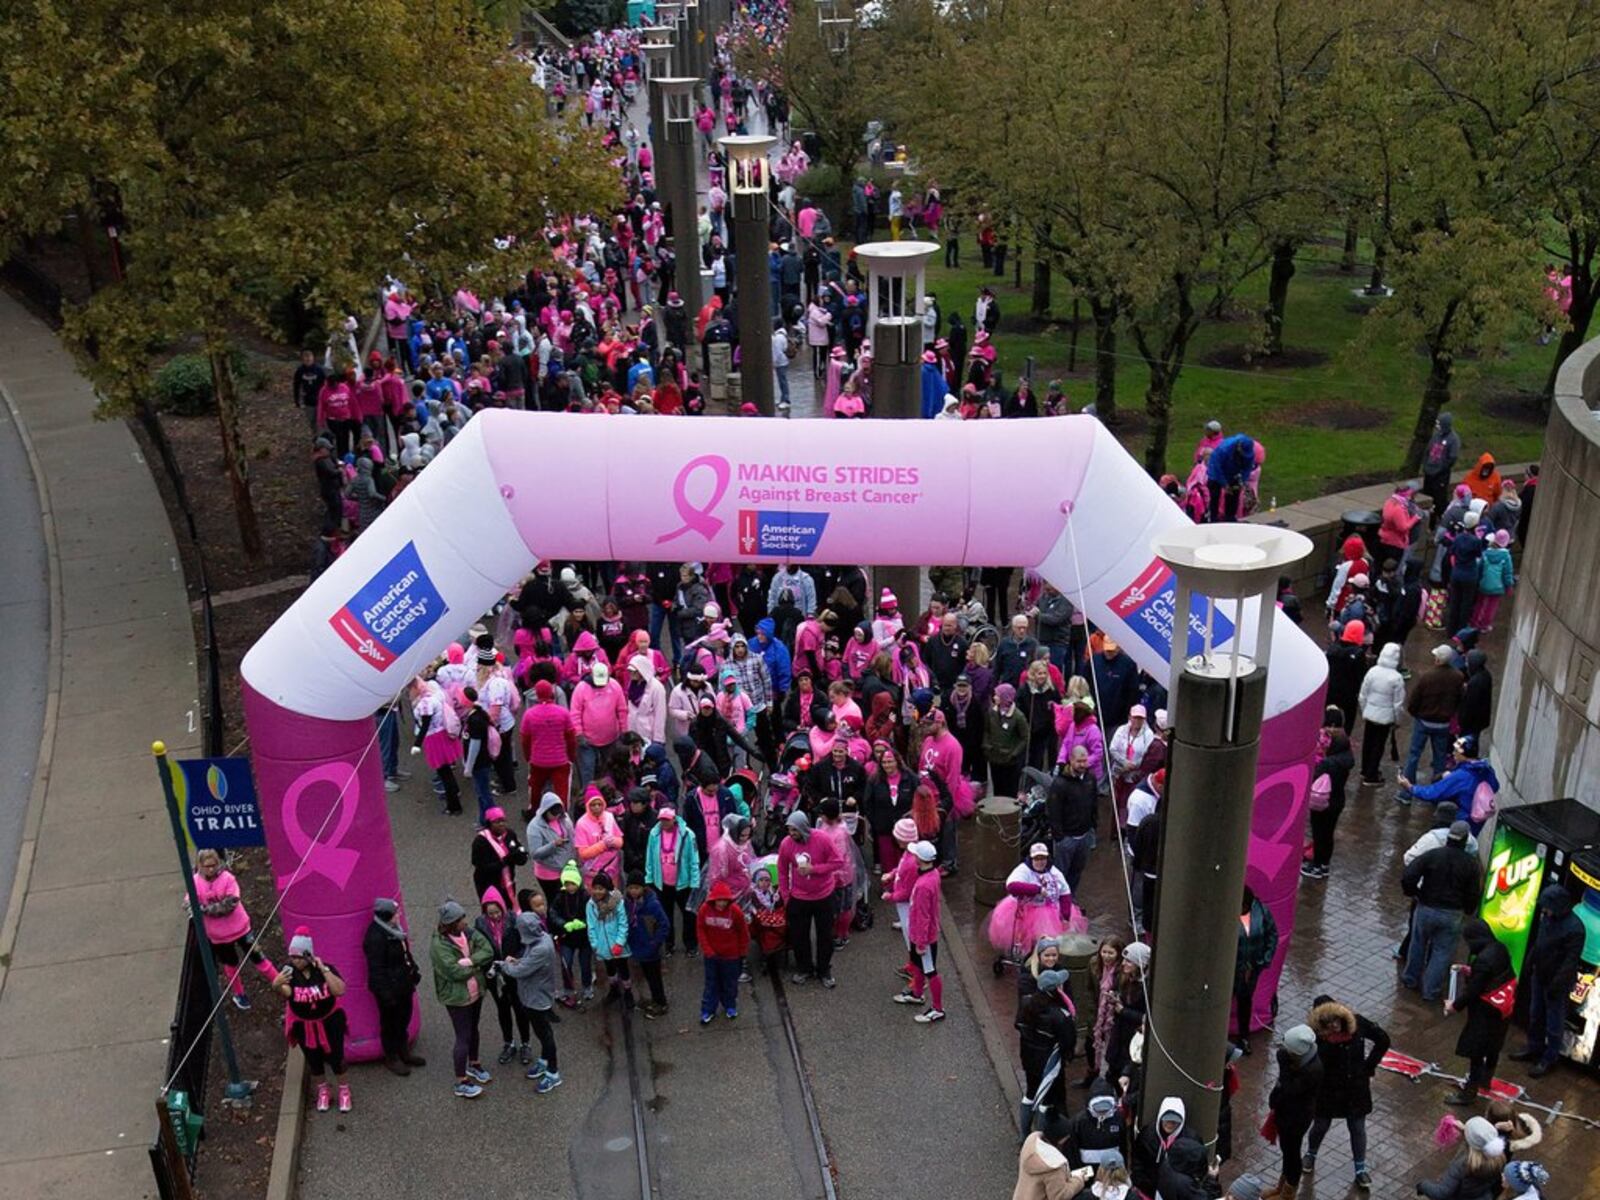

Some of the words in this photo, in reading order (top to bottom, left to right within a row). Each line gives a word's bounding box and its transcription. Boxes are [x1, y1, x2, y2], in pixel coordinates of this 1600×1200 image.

[738, 463, 828, 484] MAKING
[834, 466, 920, 485] STRIDES
[738, 486, 801, 503] Against
[804, 488, 858, 503] Breast
[861, 489, 919, 504] Cancer
[761, 523, 816, 535] American
[761, 532, 801, 543] Cancer
[761, 541, 802, 551] Society
[362, 570, 419, 625] American
[371, 593, 413, 633] Cancer
[381, 601, 427, 643] Society
[191, 804, 222, 816] OHIO
[224, 803, 255, 814] RIVER
[194, 815, 257, 831] TRAIL
[1486, 847, 1540, 899] 7UP
